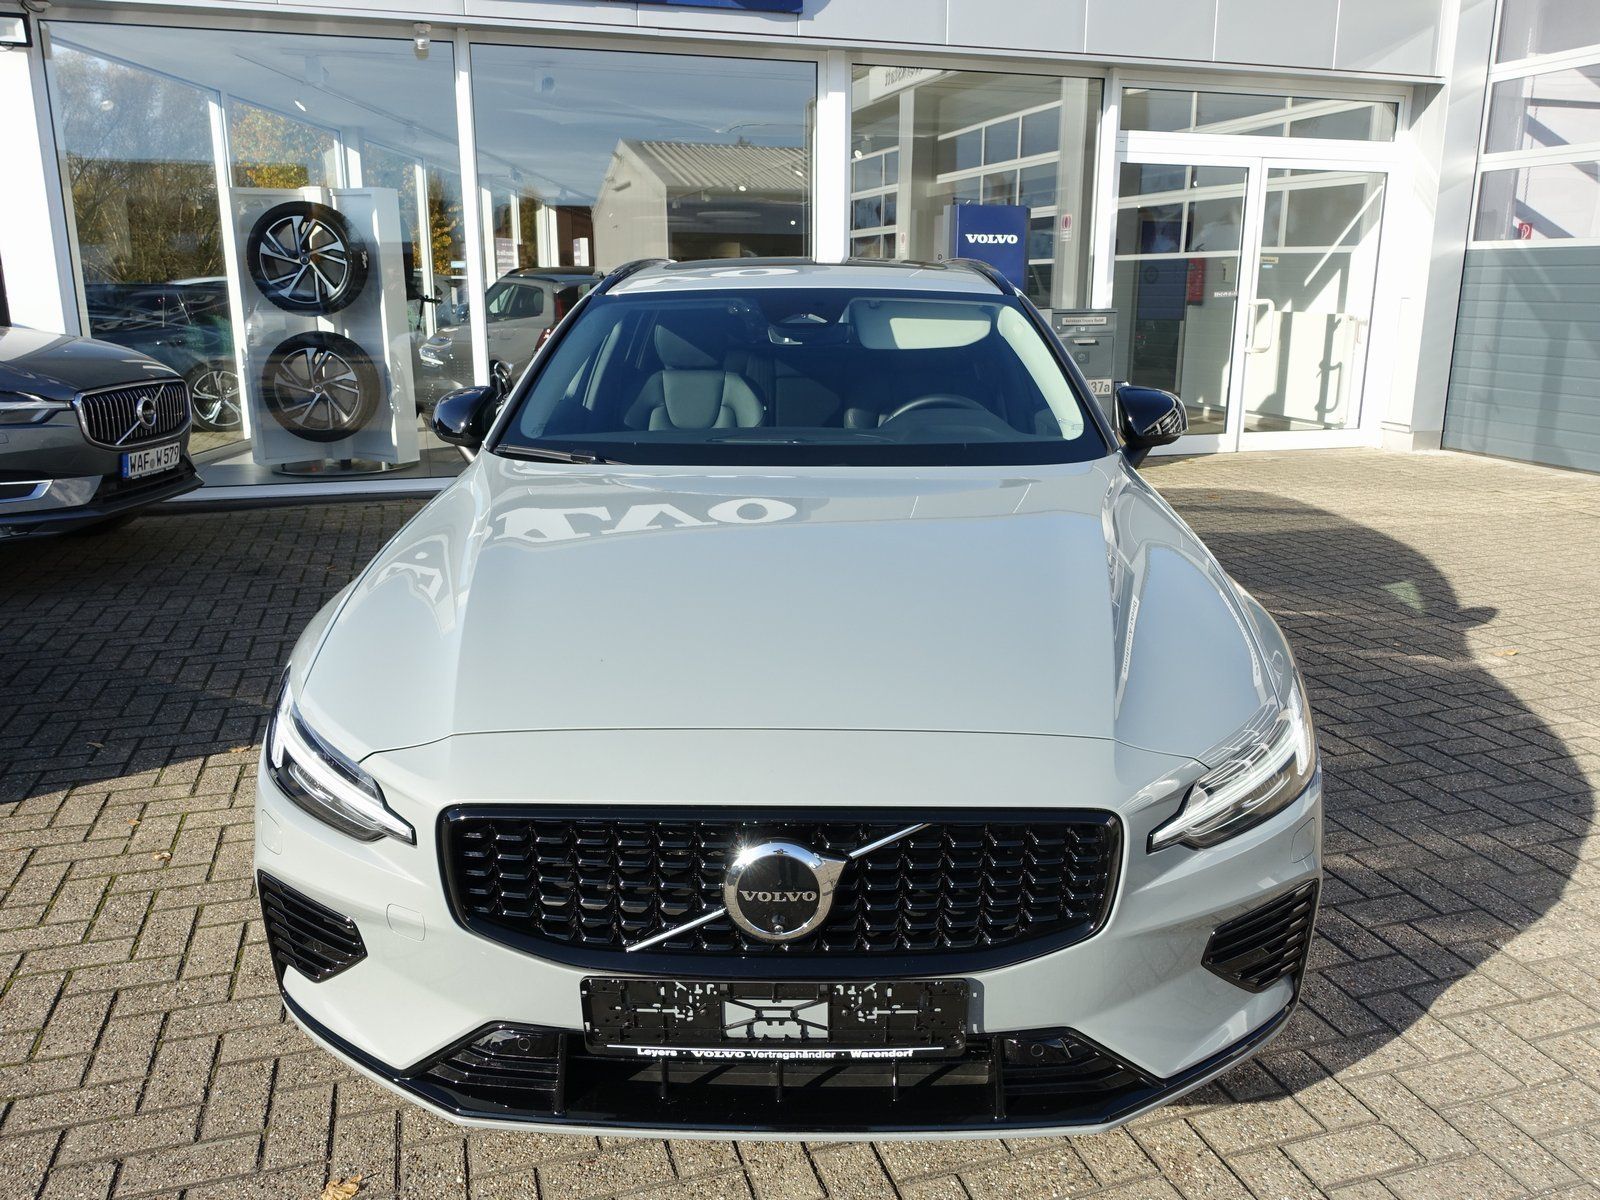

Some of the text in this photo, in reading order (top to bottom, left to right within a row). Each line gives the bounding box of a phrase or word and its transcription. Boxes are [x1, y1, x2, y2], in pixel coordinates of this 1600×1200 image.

[965, 233, 1018, 244] VOLVO
[130, 452, 149, 473] WAF
[163, 445, 178, 465] 579
[739, 889, 817, 902] VOLVO
[636, 1047, 678, 1058] Leyers
[850, 1049, 914, 1059] Warendorf
